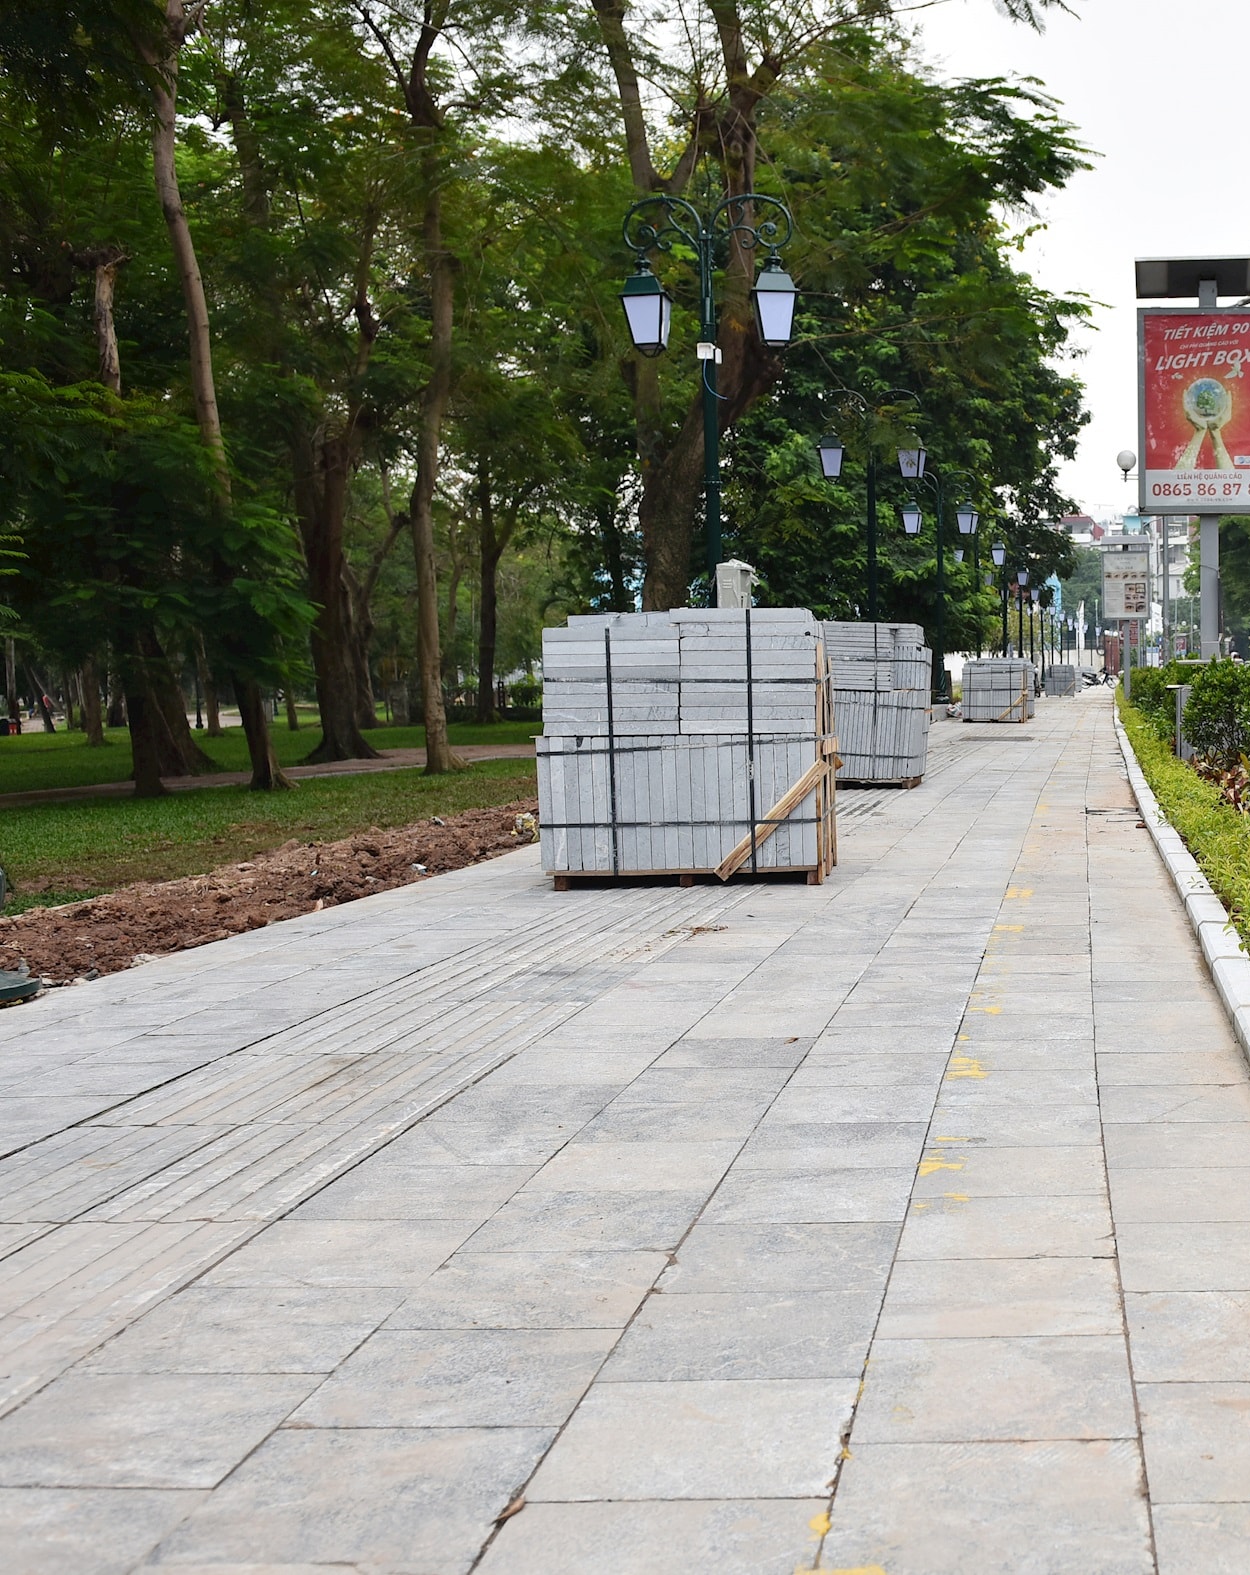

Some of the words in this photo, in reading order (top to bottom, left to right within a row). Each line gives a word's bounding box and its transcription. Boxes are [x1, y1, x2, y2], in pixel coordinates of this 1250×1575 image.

[1164, 324, 1193, 341] TIẾT
[1193, 322, 1230, 340] KIỆM
[1155, 351, 1213, 371] LIGHT
[1193, 473, 1202, 481] HỆ
[1203, 473, 1228, 481] QUẢNG
[1228, 472, 1243, 480] CÁO
[1152, 483, 1192, 496] 0865
[1197, 483, 1217, 496] 86
[1223, 483, 1242, 496] 87
